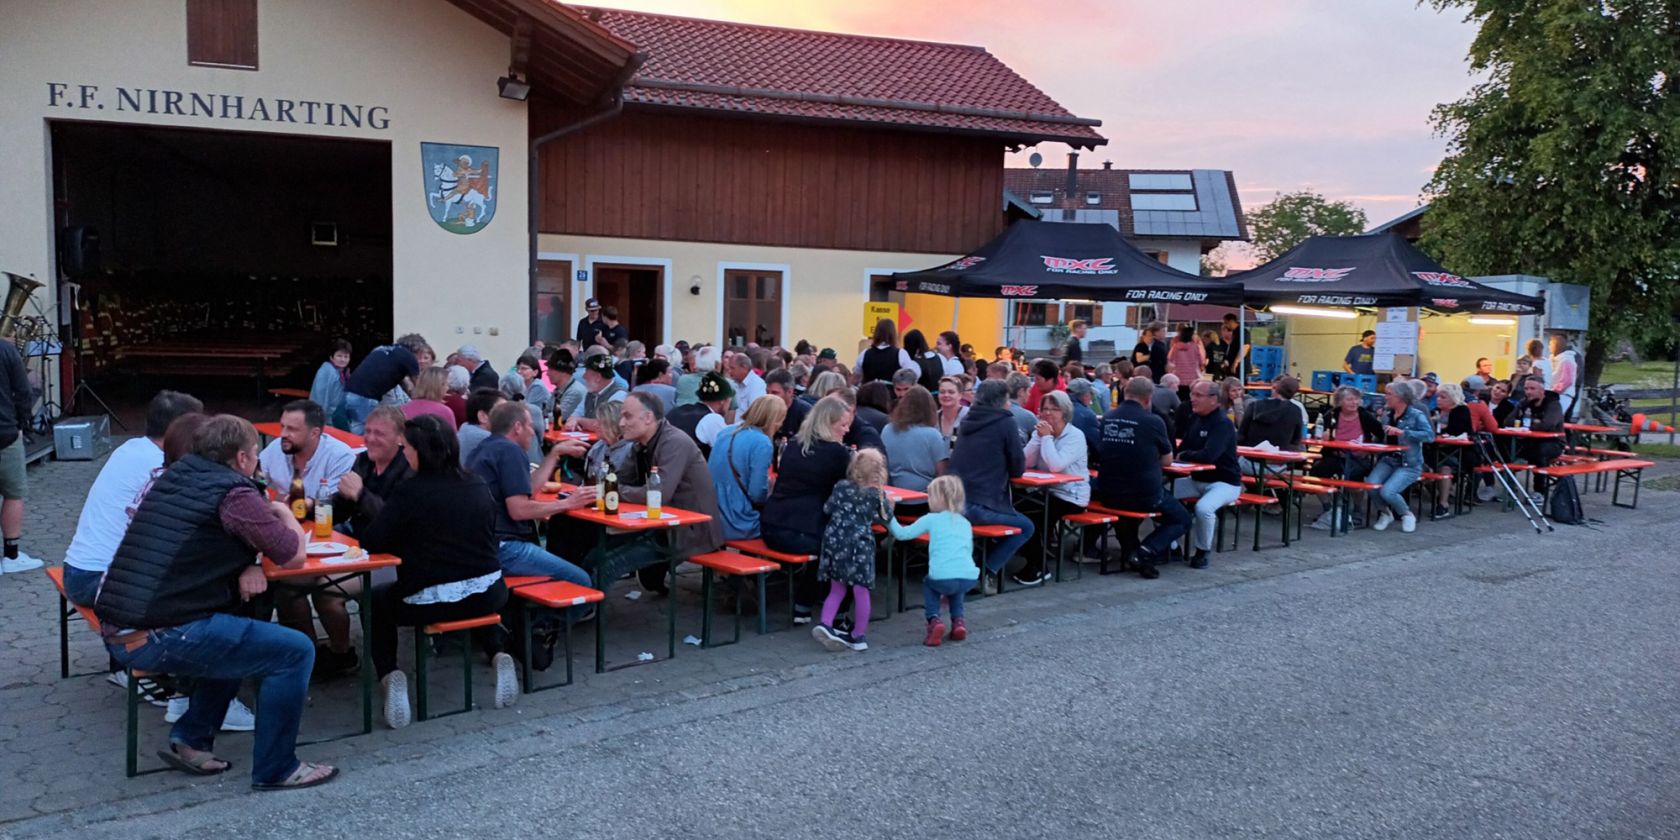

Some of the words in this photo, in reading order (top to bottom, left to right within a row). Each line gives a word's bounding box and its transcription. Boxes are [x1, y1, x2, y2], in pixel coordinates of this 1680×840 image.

[46, 82, 105, 111] F.F.
[116, 86, 392, 130] NIRNHARTING
[1040, 255, 1117, 271] MXC
[1001, 285, 1039, 296] MXC
[1125, 290, 1146, 299] FOR
[1147, 291, 1182, 301] RACING
[1184, 292, 1208, 301] ONLY
[1297, 295, 1317, 304] FOR
[1317, 296, 1353, 305] RACING
[1353, 297, 1379, 305] ONLY
